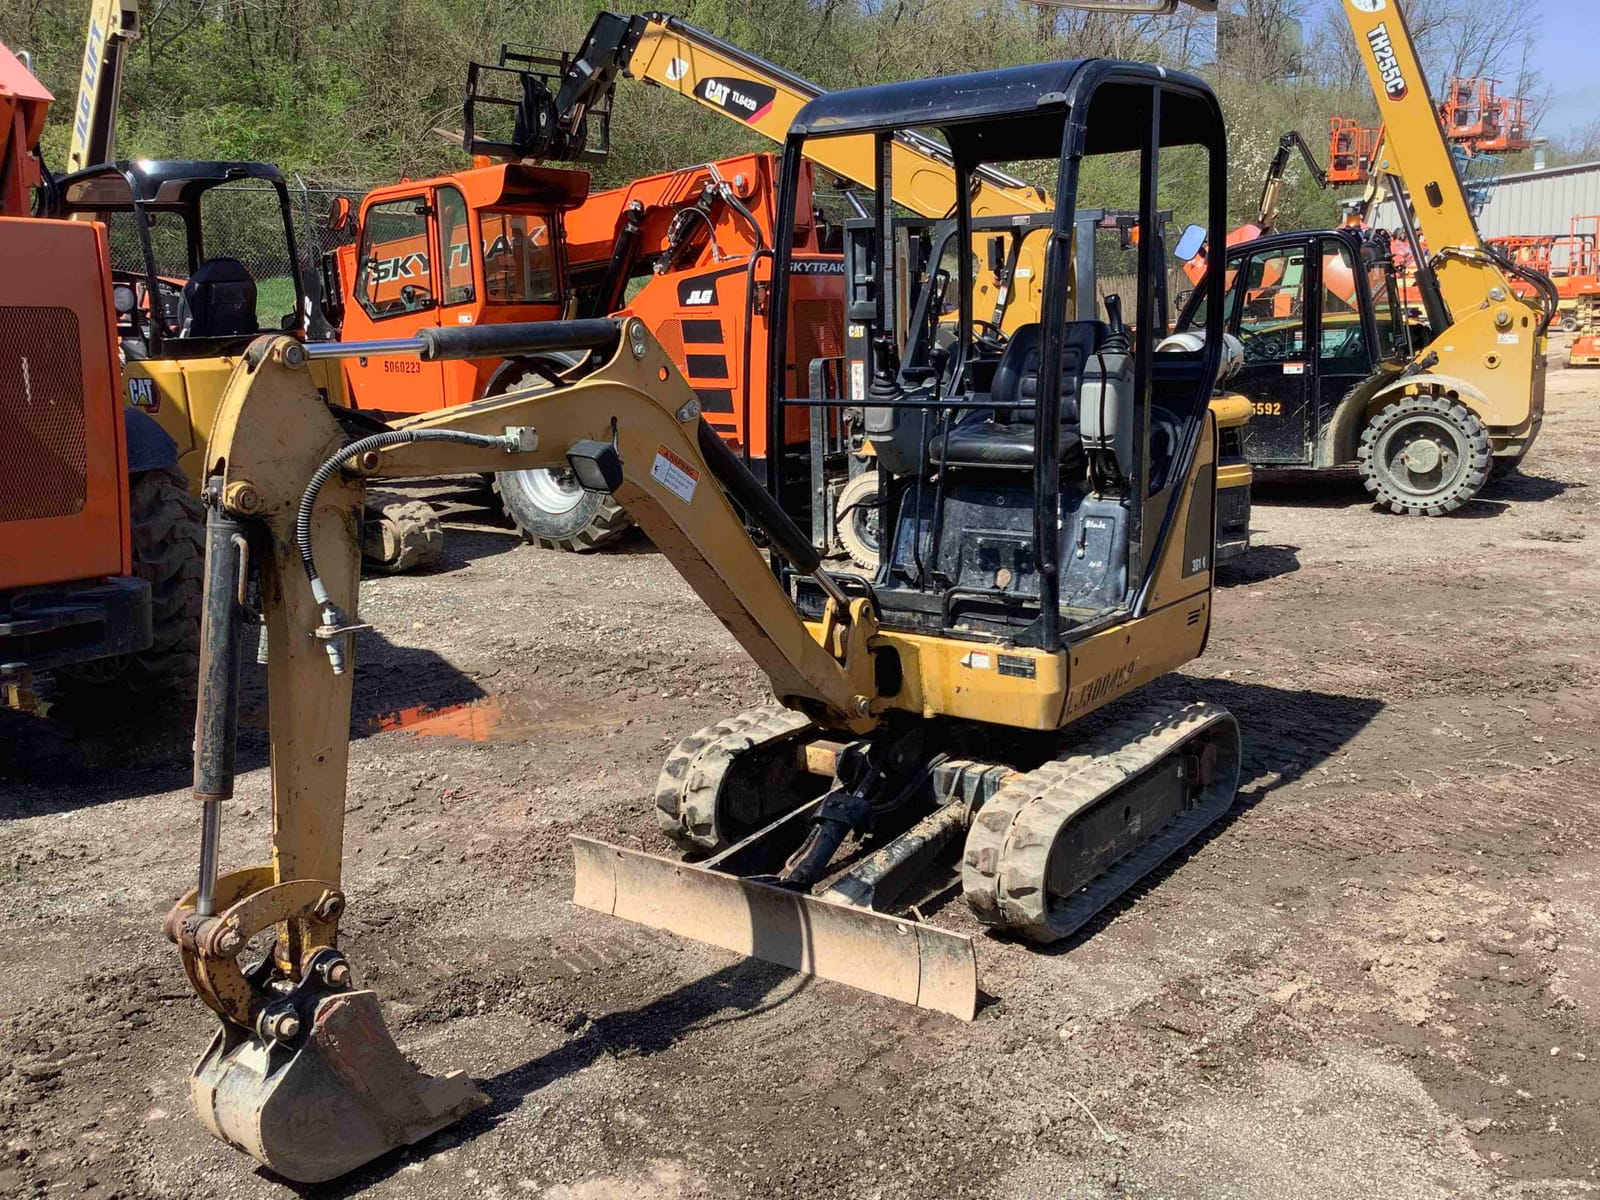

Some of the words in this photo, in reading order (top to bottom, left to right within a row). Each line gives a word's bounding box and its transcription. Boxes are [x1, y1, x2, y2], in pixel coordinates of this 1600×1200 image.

[1367, 22, 1406, 94] TH255C
[76, 91, 91, 150] JLG
[84, 19, 102, 91] LIFT
[704, 79, 731, 107] CAT
[789, 261, 845, 273] KYTRAK
[685, 289, 713, 305] JLG
[848, 325, 865, 338] CAT
[384, 360, 421, 374] 5060223
[128, 378, 153, 406] CAT
